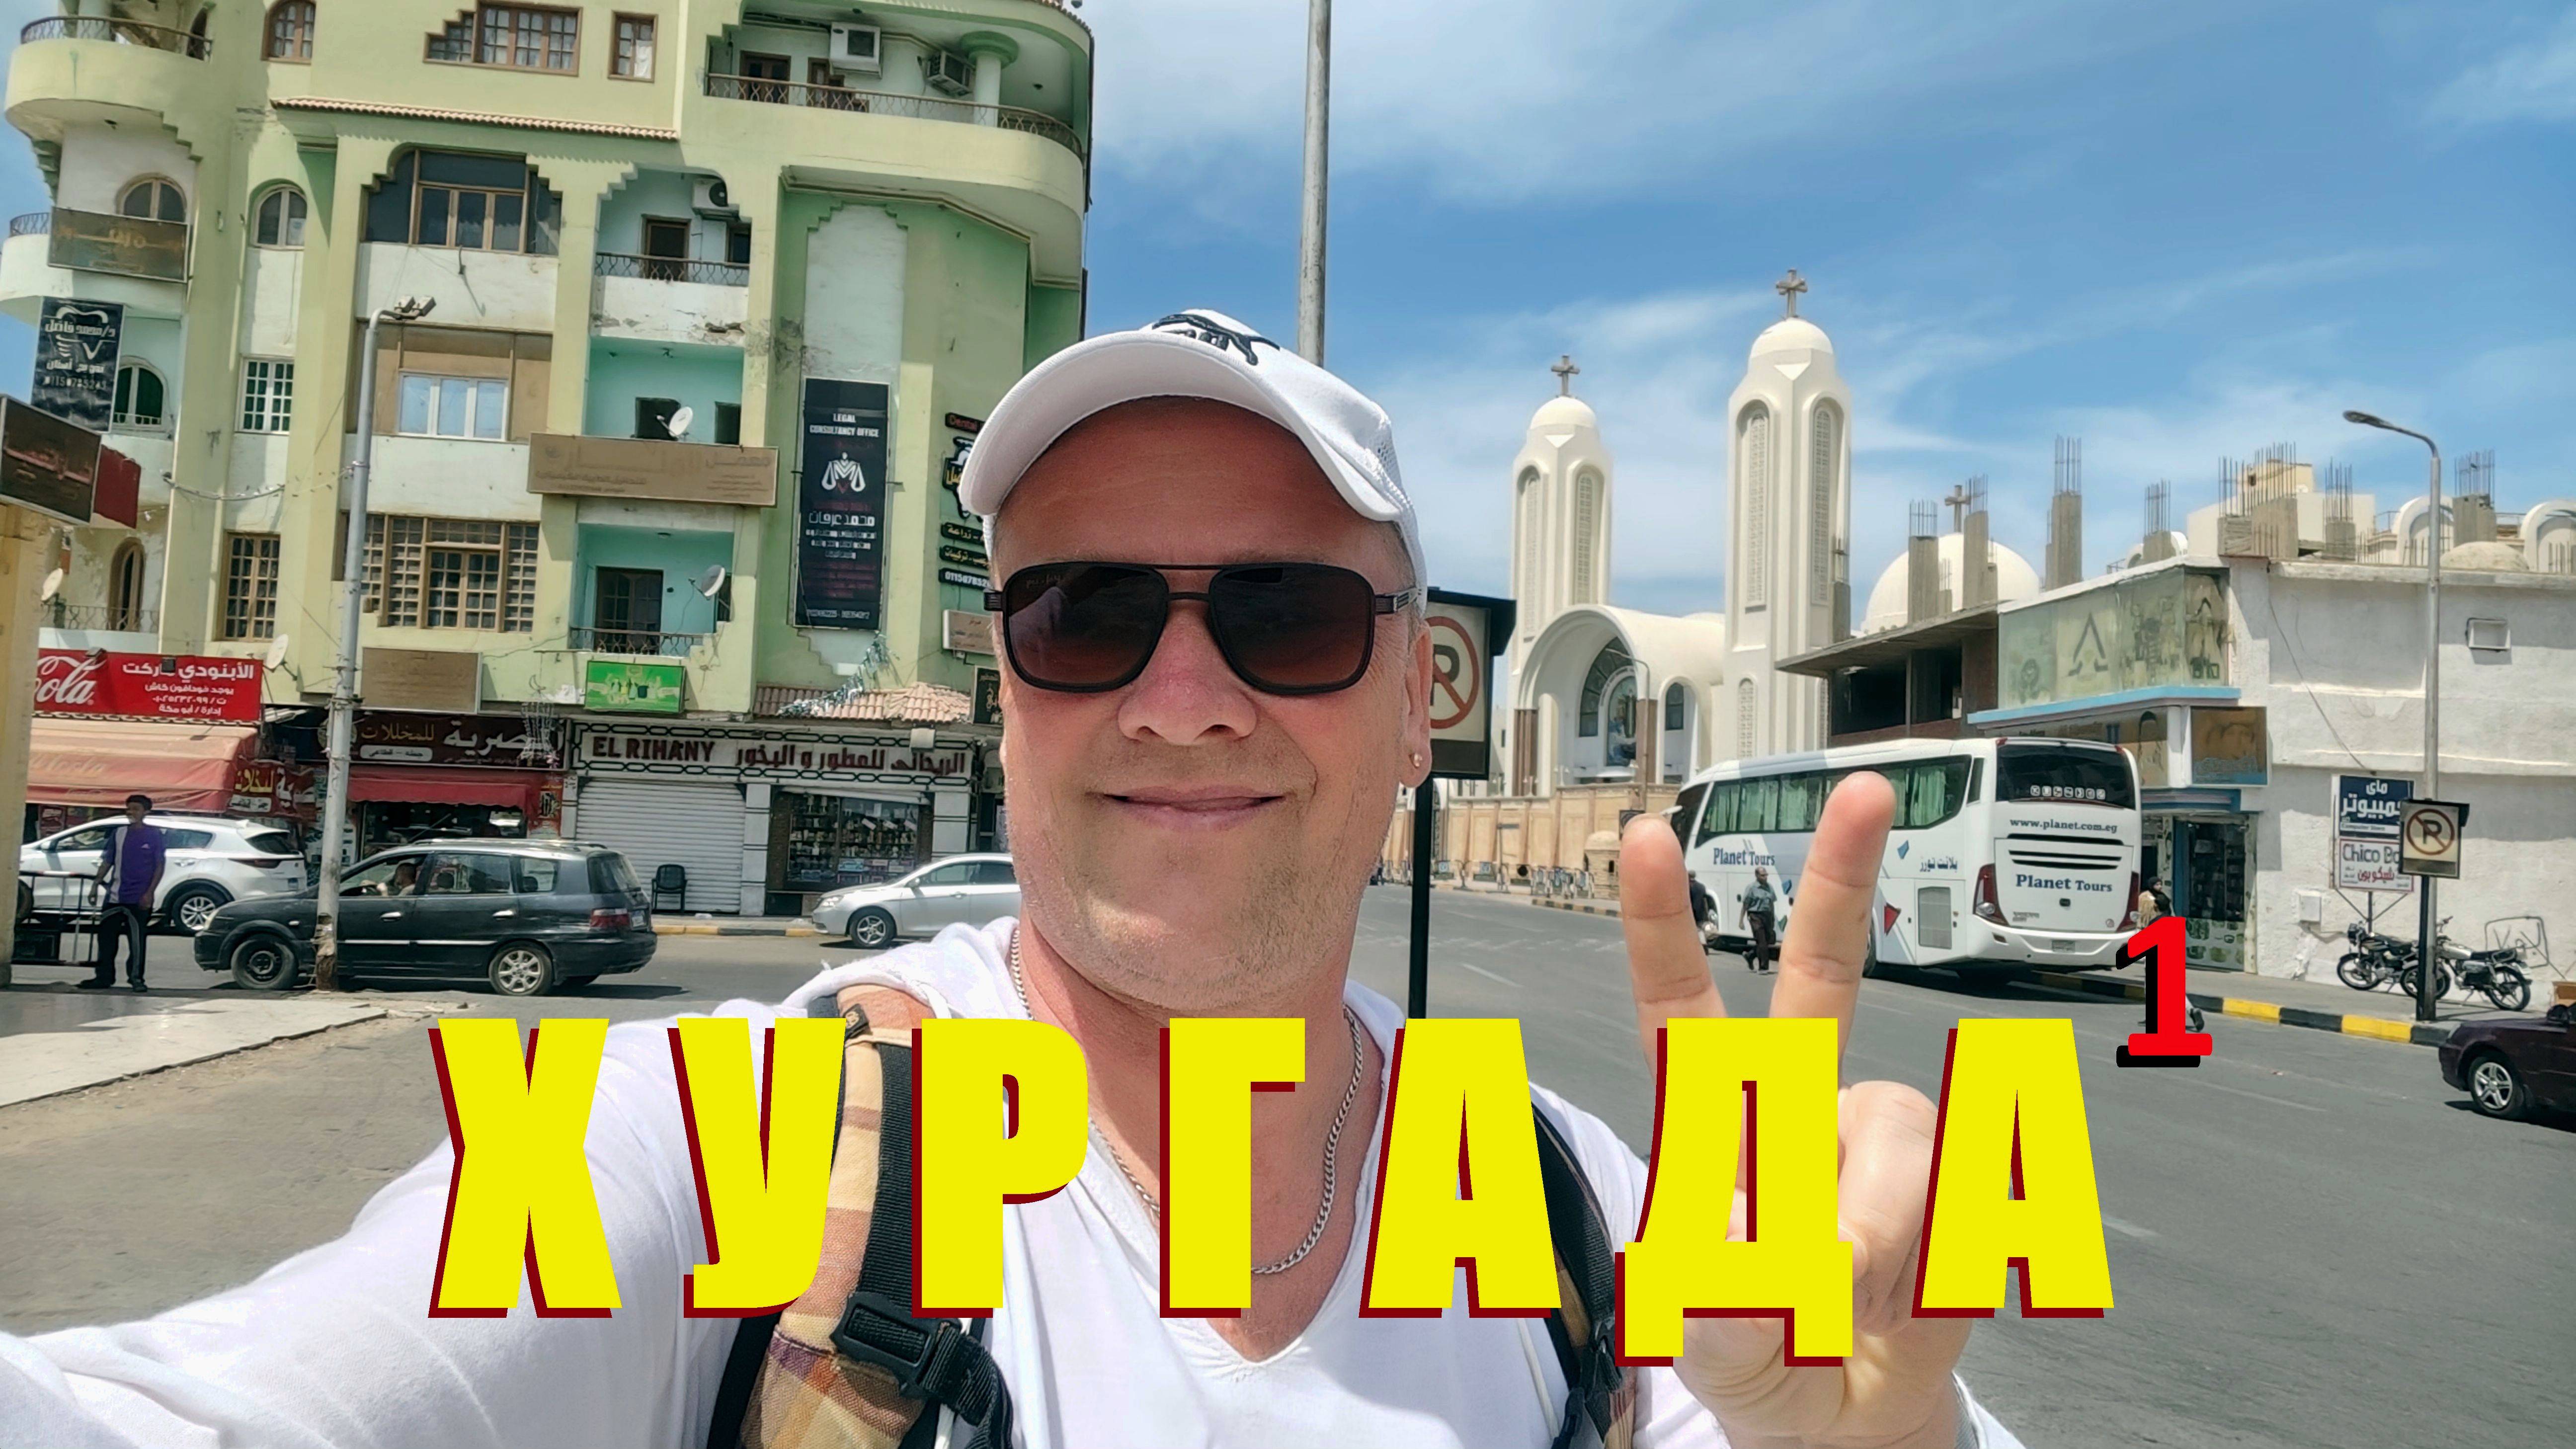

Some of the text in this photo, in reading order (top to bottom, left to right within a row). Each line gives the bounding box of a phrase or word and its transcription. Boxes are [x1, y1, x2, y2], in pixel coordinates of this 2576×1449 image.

[833, 413, 856, 422] LEGAL
[178, 662, 254, 683] الأبنودي
[592, 736, 715, 762] EL RIHANY
[2341, 793, 2401, 819] مبيوتر
[2010, 819, 2118, 834] www.planet.com.eg
[1713, 848, 1775, 866] Planet Tours
[2342, 843, 2381, 863] Chico
[2015, 874, 2113, 892] Planet Tours
